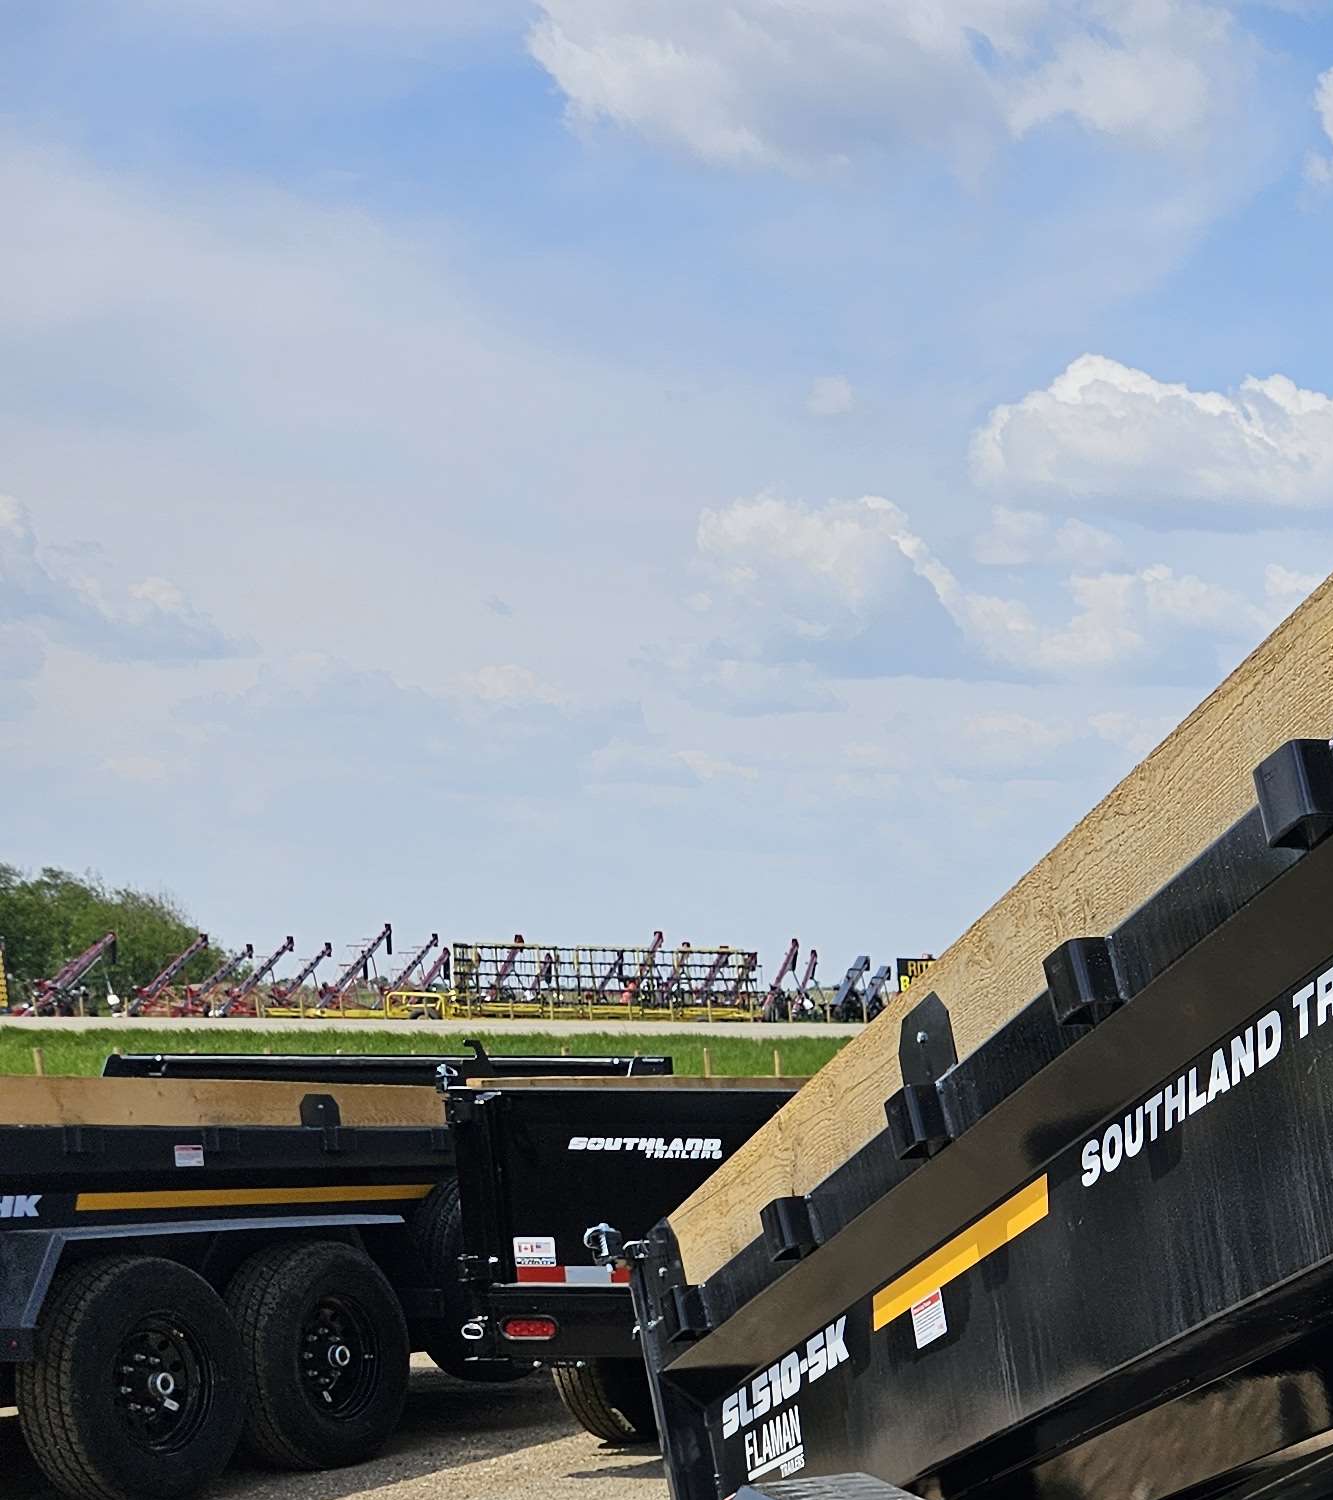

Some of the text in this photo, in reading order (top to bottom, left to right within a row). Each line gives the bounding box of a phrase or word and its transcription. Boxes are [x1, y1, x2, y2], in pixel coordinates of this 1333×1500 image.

[1081, 1010, 1283, 1188] SOUTHLAND
[568, 1137, 722, 1151] SOUTHLAND
[645, 1150, 722, 1160] TRAILERS
[722, 1315, 850, 1440] SL510-5K
[744, 1405, 802, 1471] FLAMAN
